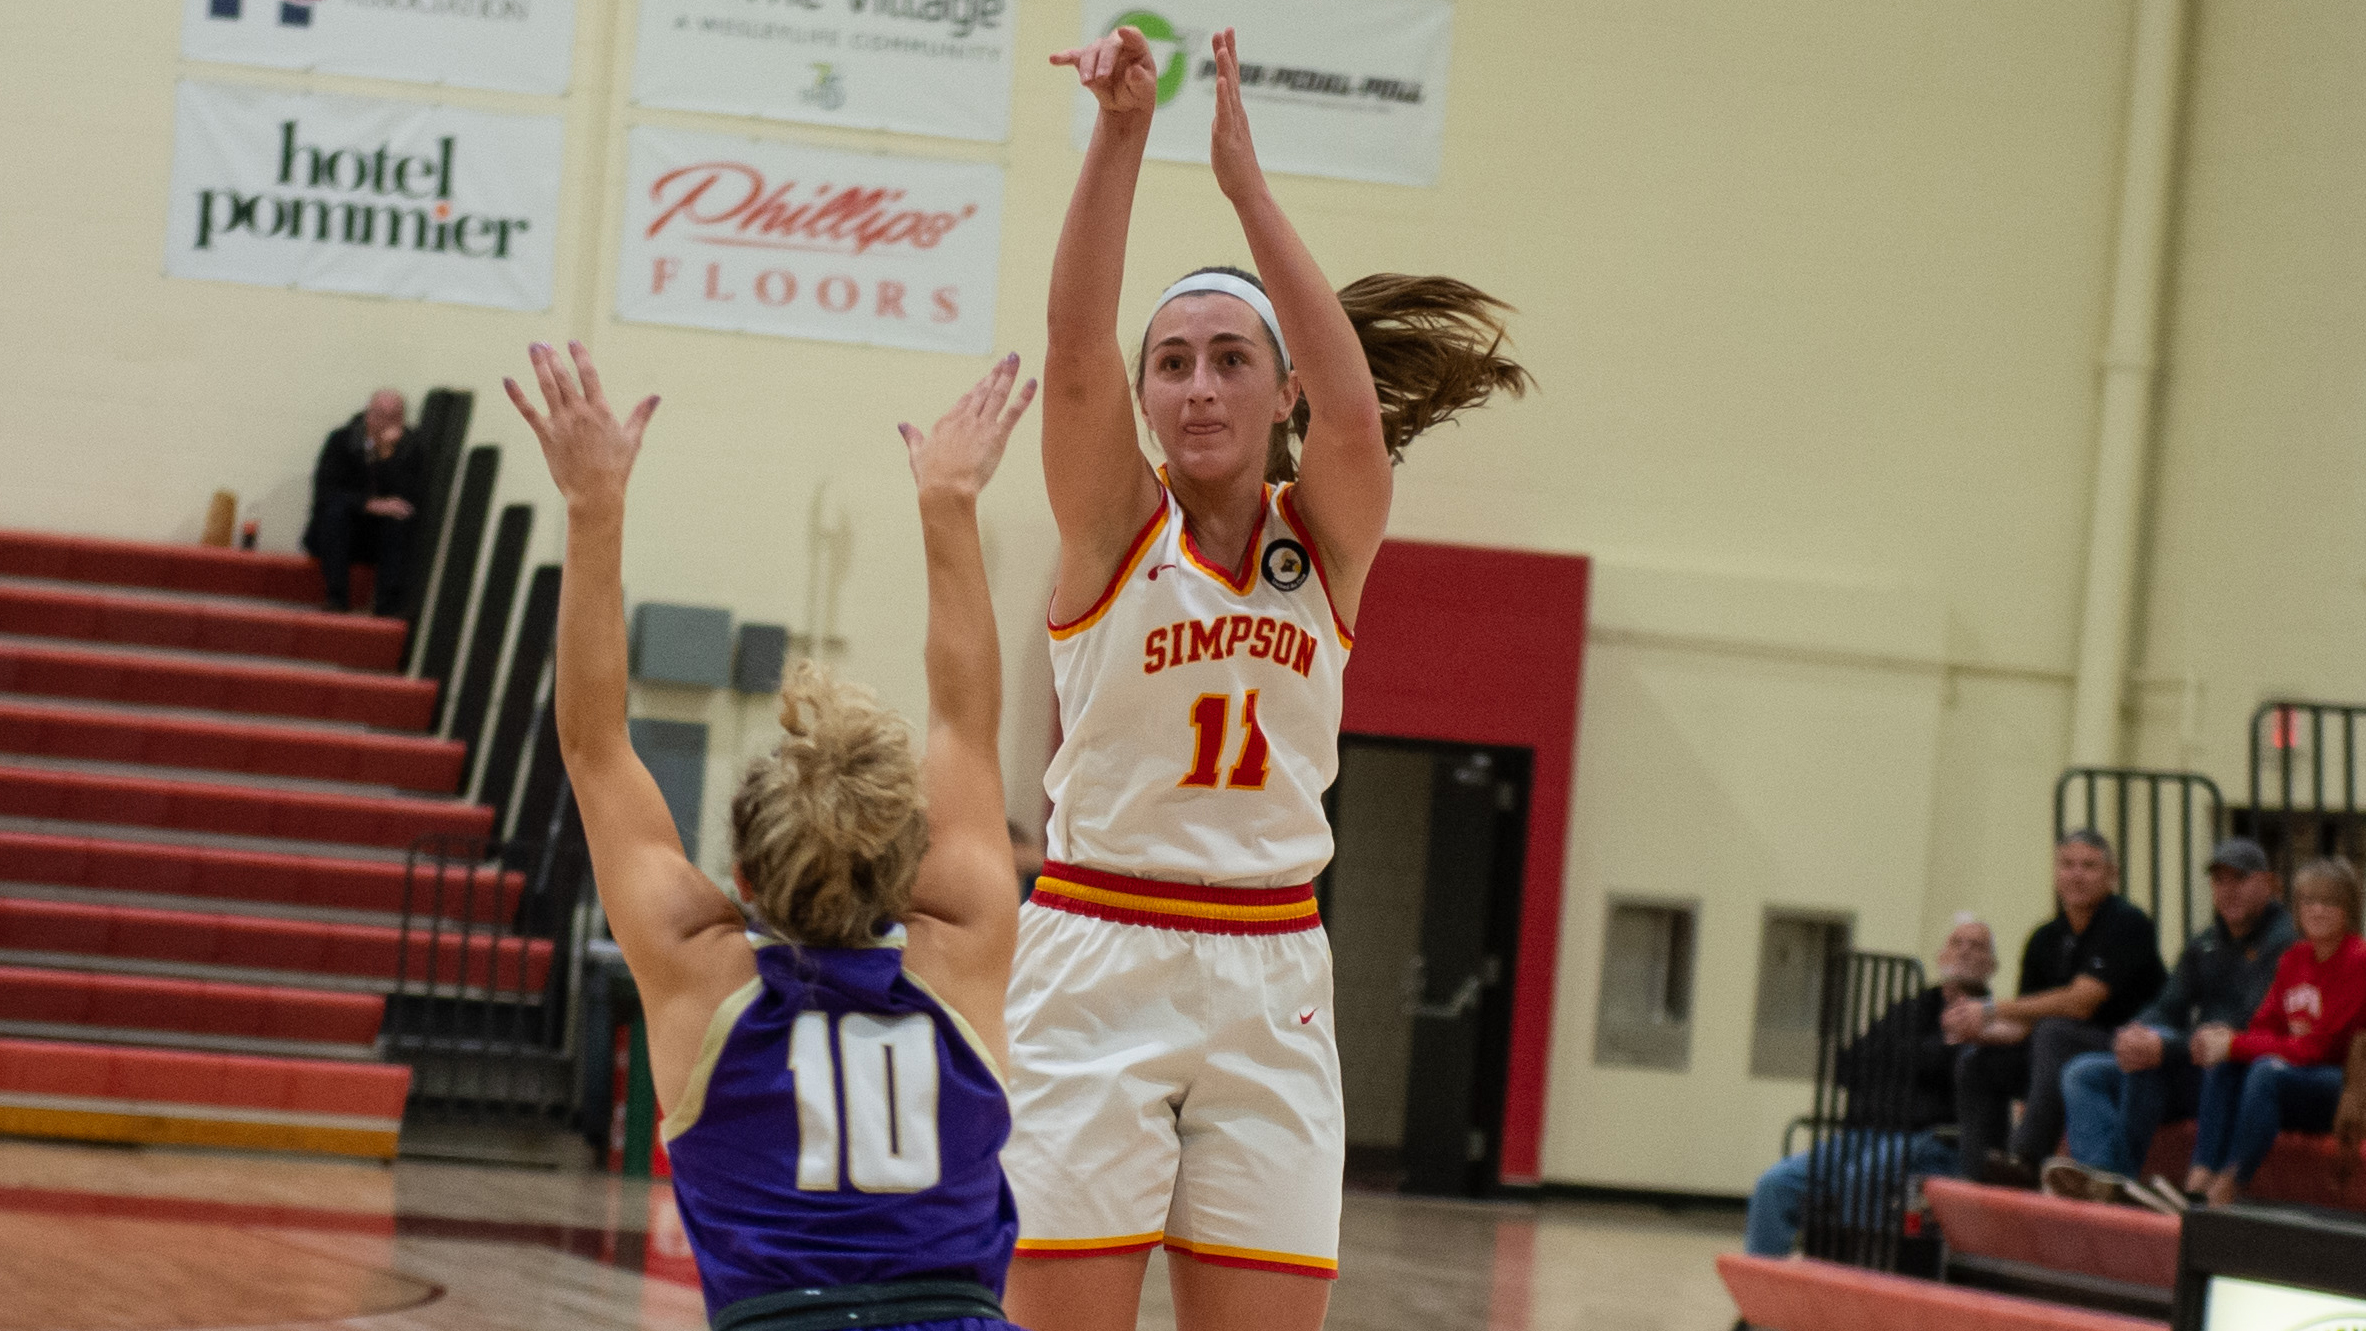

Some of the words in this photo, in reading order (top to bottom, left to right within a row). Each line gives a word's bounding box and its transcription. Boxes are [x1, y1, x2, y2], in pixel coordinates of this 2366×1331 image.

[277, 119, 456, 199] hotel
[194, 188, 531, 259] pommier
[651, 256, 960, 323] FLOORS
[1143, 614, 1317, 678] SIMPSON
[1177, 688, 1270, 790] 11
[787, 1009, 941, 1194] 10
